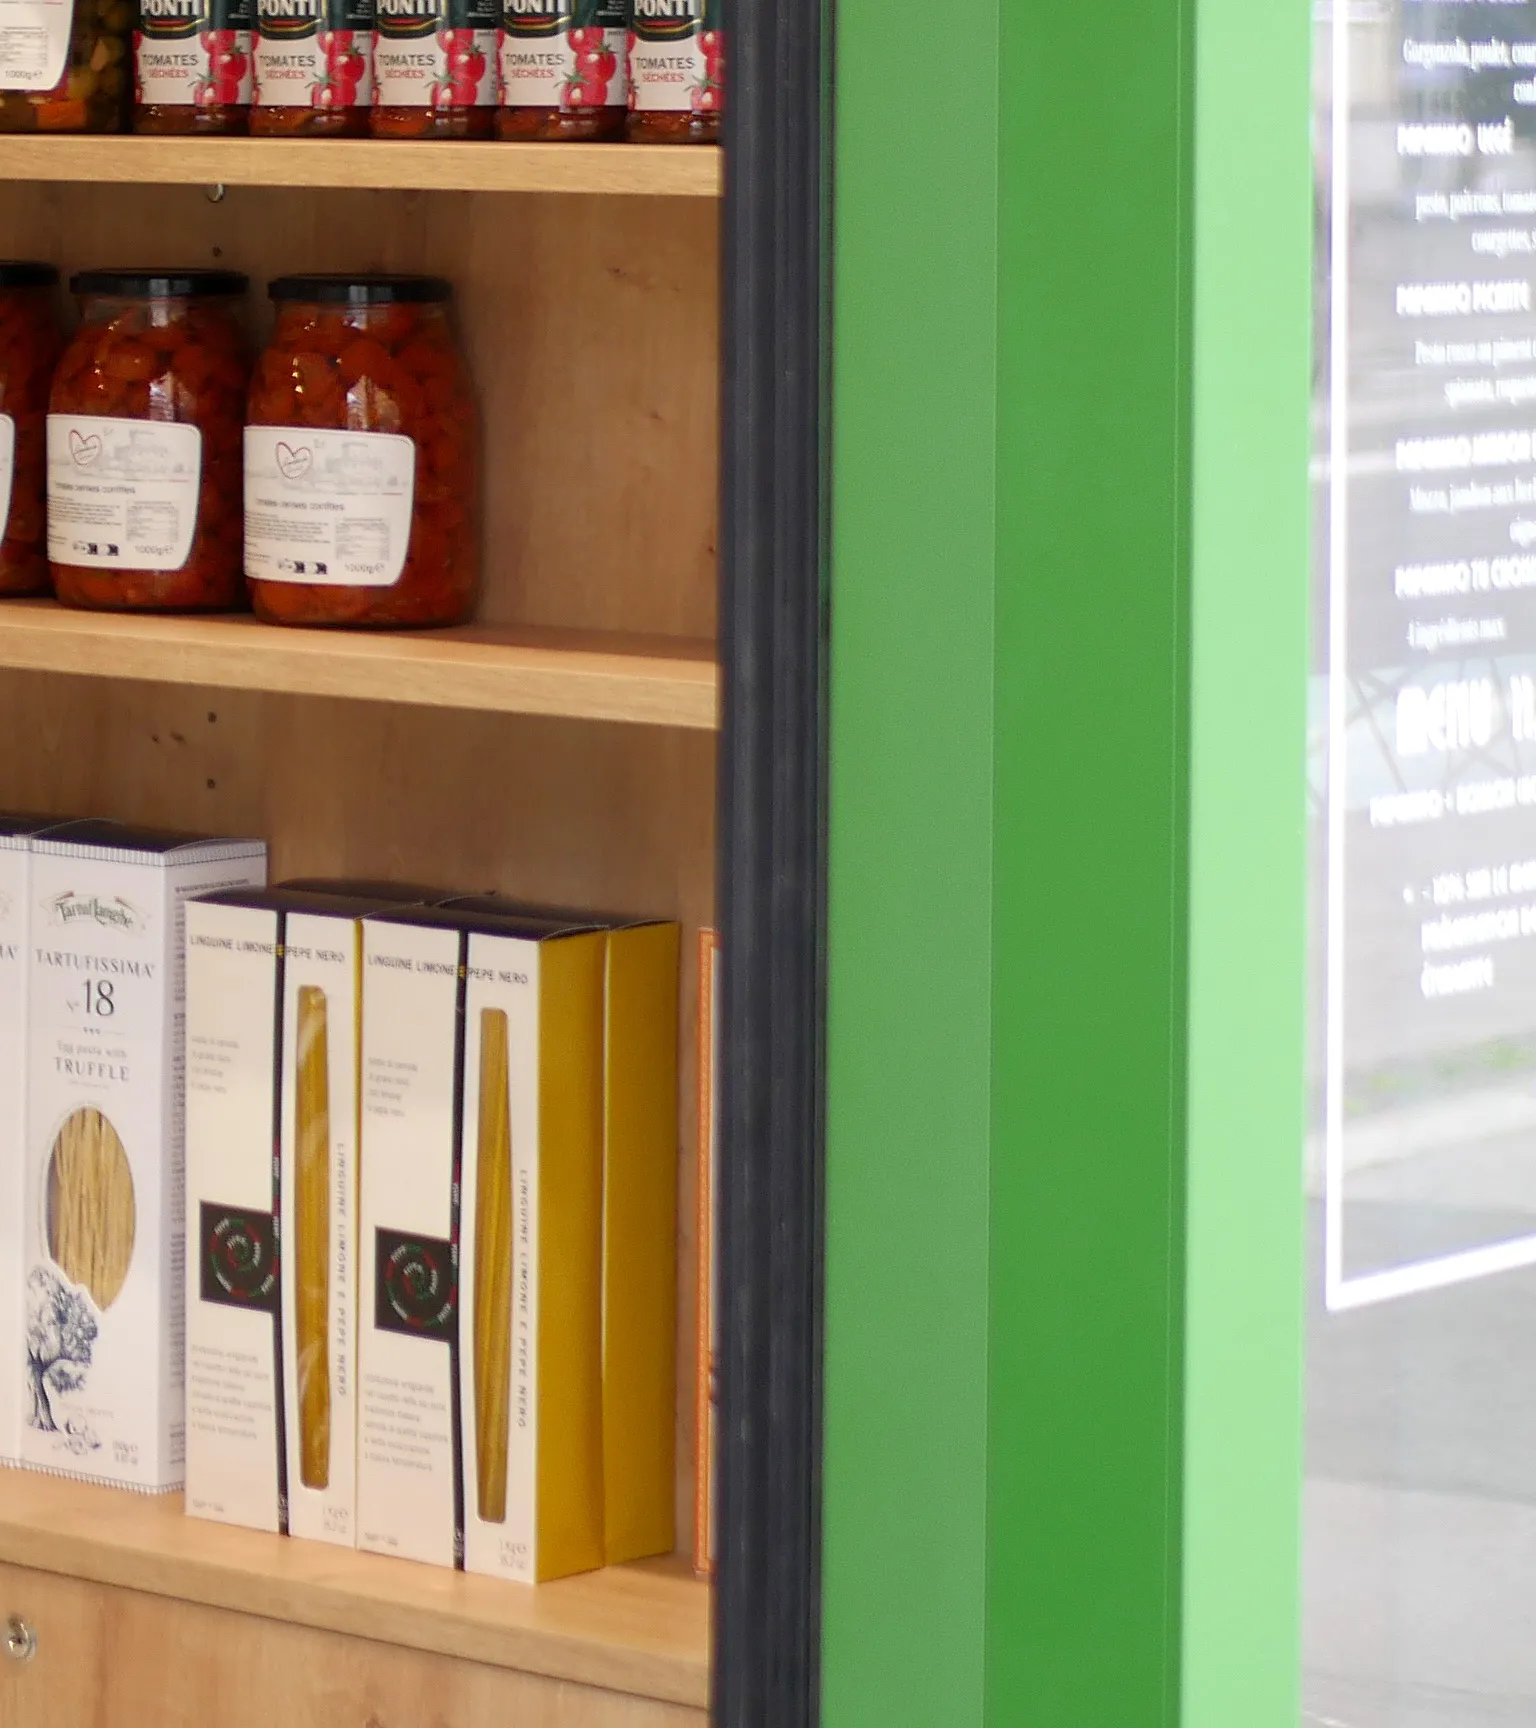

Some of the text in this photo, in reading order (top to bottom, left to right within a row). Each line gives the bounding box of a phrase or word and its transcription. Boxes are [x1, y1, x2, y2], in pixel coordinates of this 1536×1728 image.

[143, 54, 198, 66] TOMATES
[259, 54, 316, 67] TOMATES
[379, 54, 437, 67] TOMATES
[505, 53, 566, 66] TOMATES
[636, 57, 696, 70] TOMATES
[1396, 677, 1493, 755] MENU
[189, 935, 346, 964] LINGUINE LIMONE PEPE NERO
[368, 953, 528, 985] LINGUINE LIMONE PEPE NERO
[83, 978, 115, 1017] 18
[53, 1056, 129, 1082] TRUFFLE
[337, 1142, 346, 1396] LINGUINE LIMONE PEPE NERO
[518, 1170, 528, 1428] LINGUINE LIMONE PEPE NERO
